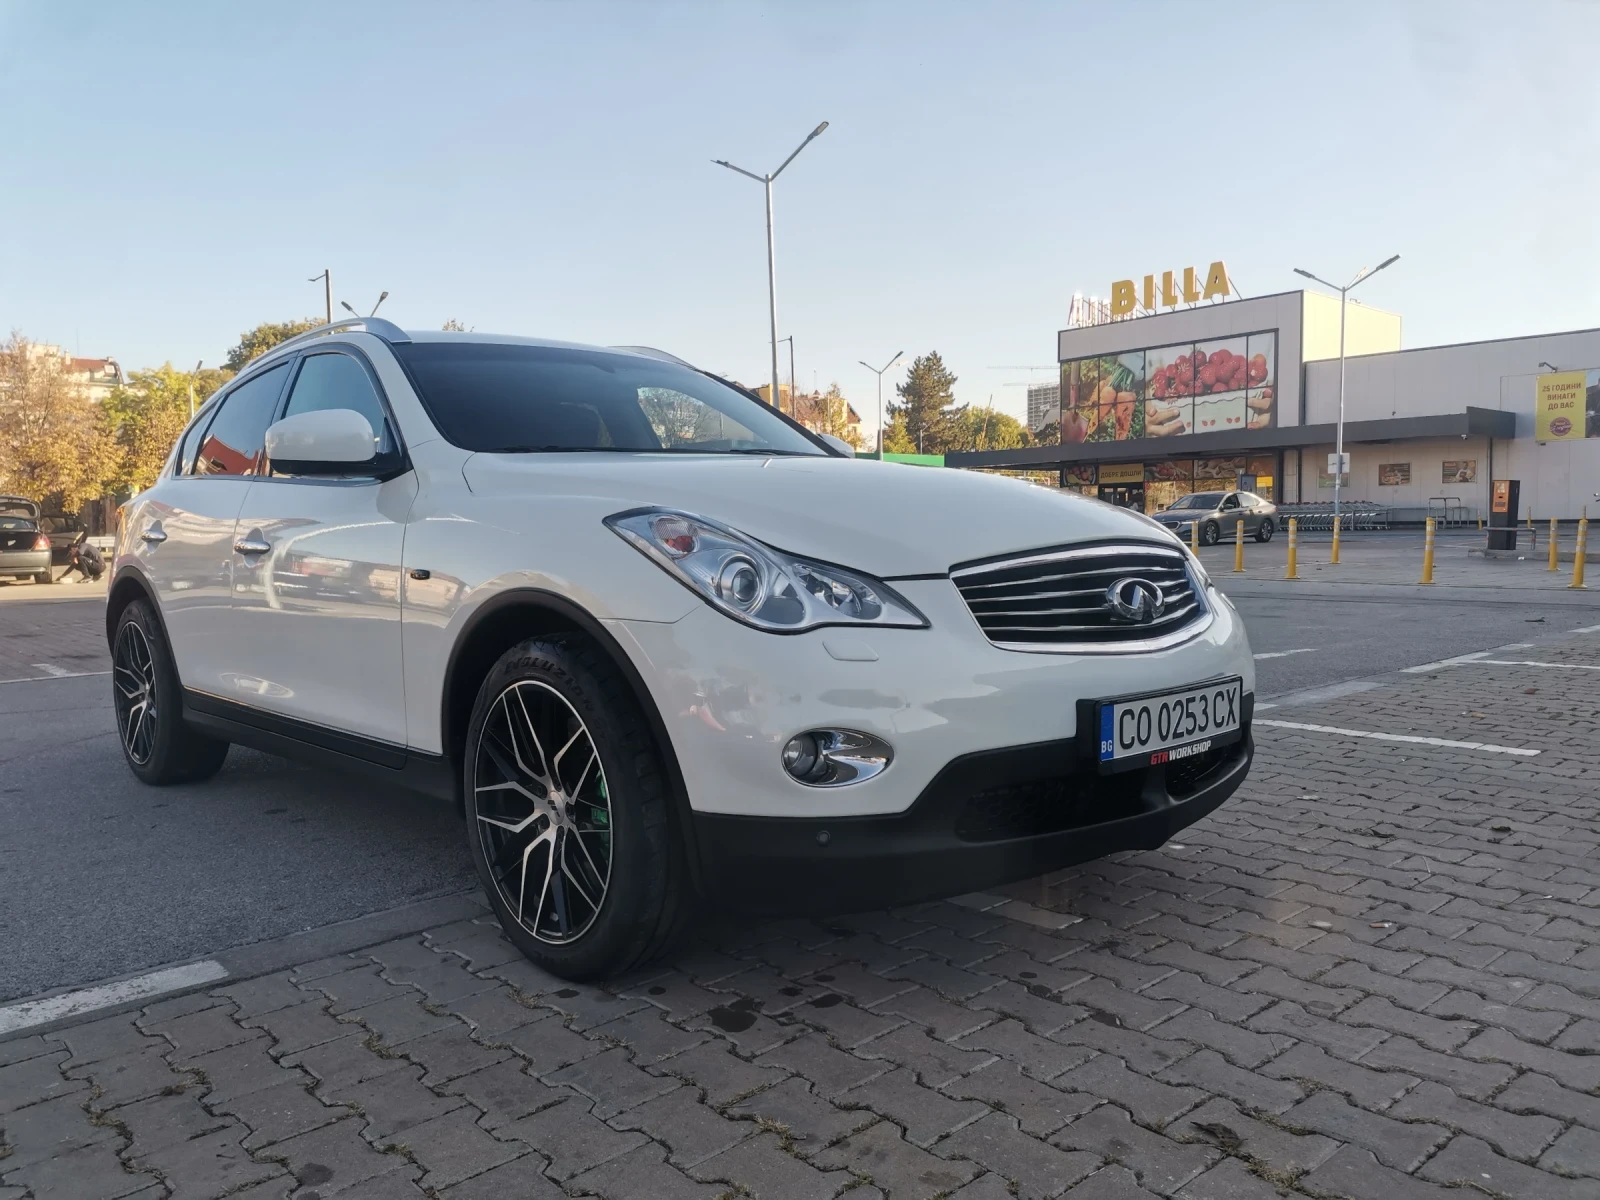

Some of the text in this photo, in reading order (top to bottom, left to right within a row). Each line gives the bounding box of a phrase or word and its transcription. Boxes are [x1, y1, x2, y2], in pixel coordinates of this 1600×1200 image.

[1112, 261, 1232, 315] BILLA
[1552, 383, 1581, 391] ГОДИНИ
[1547, 392, 1575, 400] ВИНАГИ
[1158, 694, 1209, 741] 0253
[1101, 740, 1113, 754] BG
